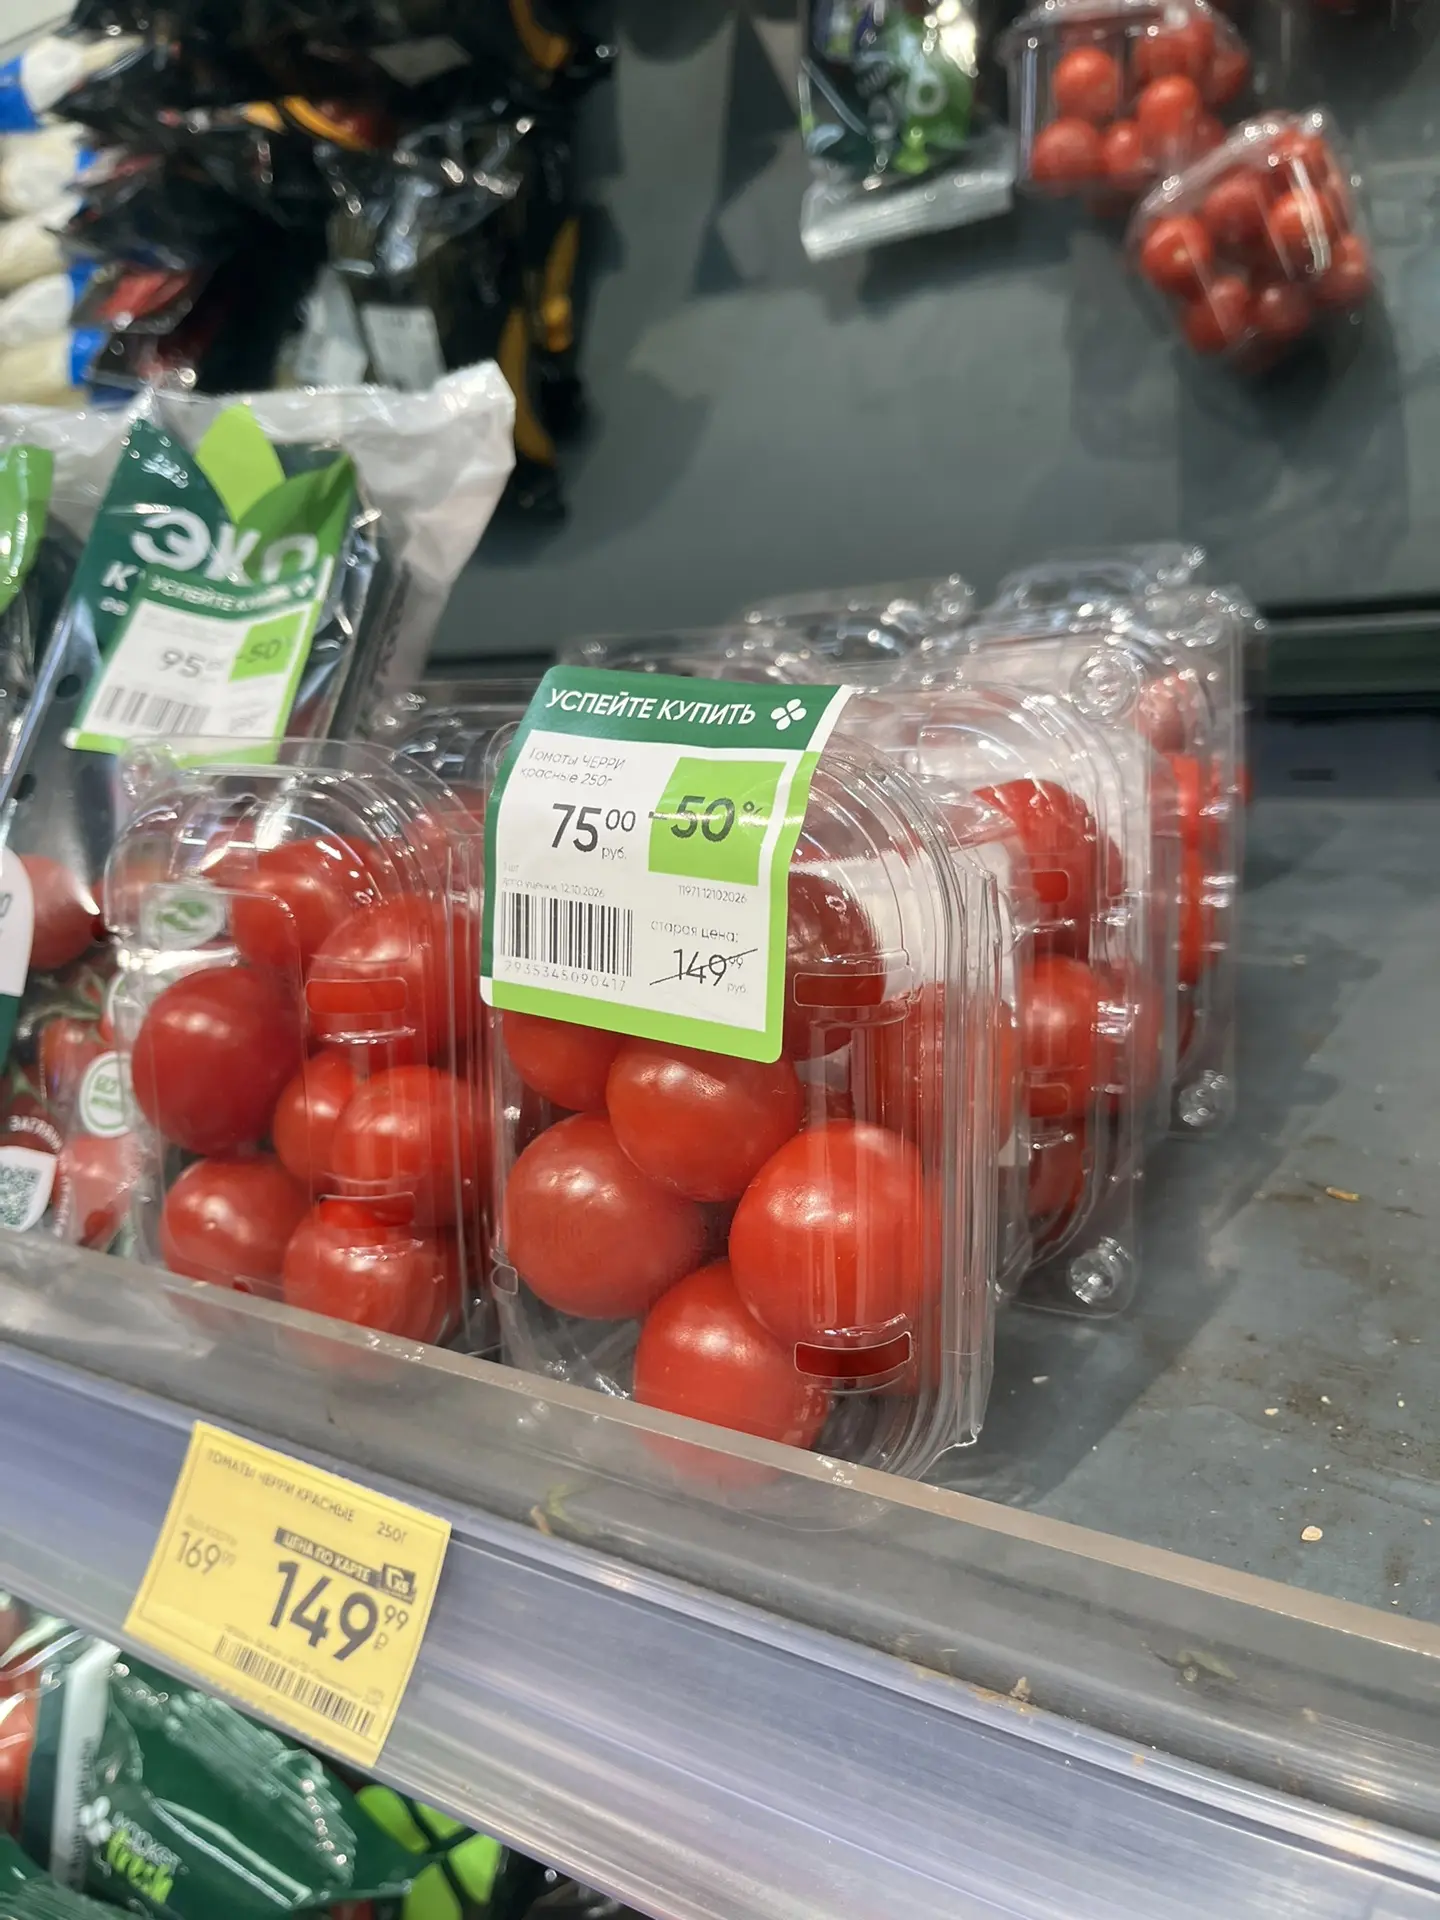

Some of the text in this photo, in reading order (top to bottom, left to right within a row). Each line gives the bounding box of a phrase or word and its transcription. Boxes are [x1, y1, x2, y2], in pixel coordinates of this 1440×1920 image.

[545, 688, 757, 726] УСПЕЙТЕ КУПИТЬ
[529, 747, 627, 771] Томаты ЧЕРРИ
[519, 767, 613, 787] красные 250г
[601, 846, 627, 861] руб.
[650, 920, 739, 944] старая цена:
[503, 960, 627, 992] 2935345090417
[206, 1448, 257, 1479] ТОМАТЫ
[258, 1471, 295, 1496] ЧЕРРИ
[296, 1488, 356, 1523] КРАСНЫЕ
[176, 1531, 221, 1576] 169
[282, 1532, 374, 1583] ЦЕНА ПО КАРТЕ
[269, 1560, 410, 1662] 149 99
